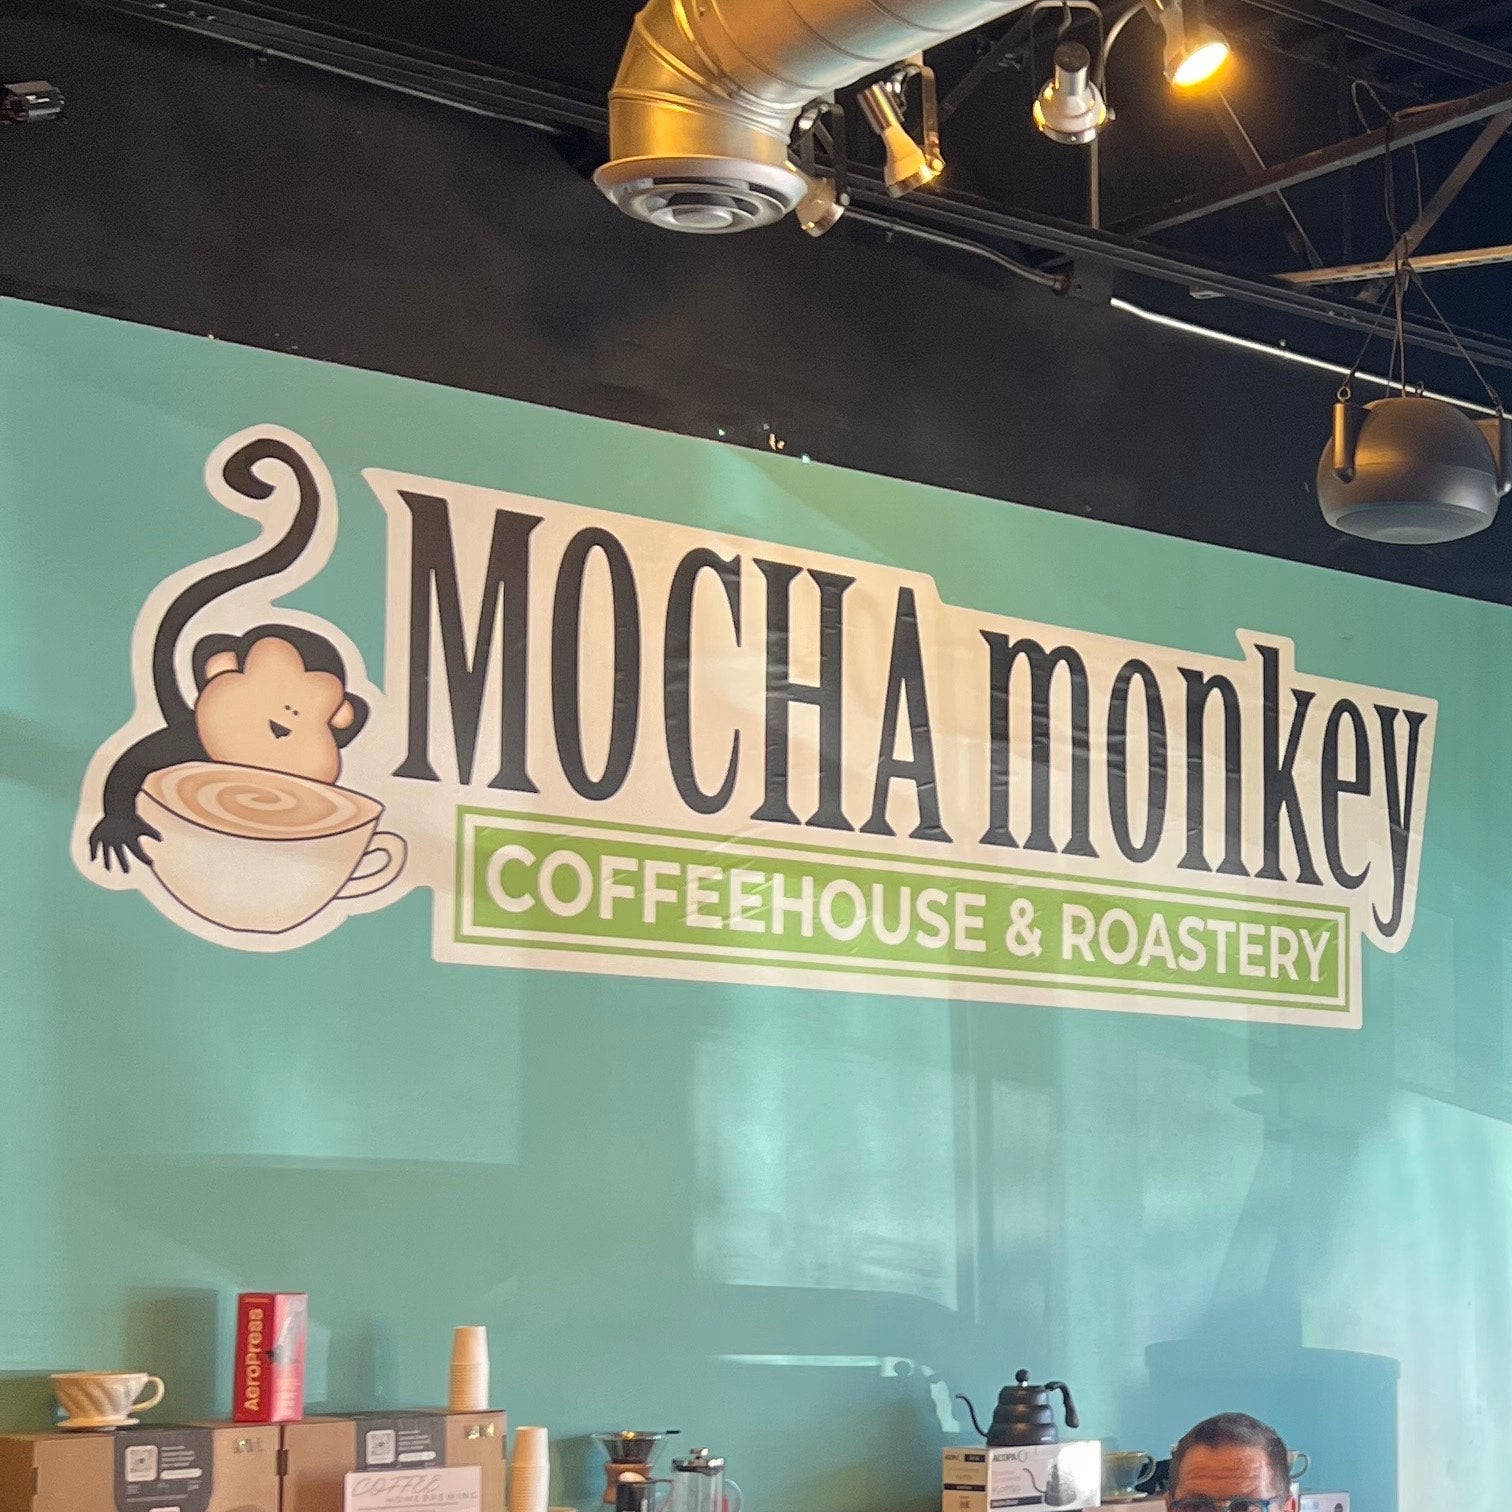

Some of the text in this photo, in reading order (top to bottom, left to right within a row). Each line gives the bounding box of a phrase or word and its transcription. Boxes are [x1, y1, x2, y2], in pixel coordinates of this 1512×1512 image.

[392, 490, 1427, 937] MOCHA monkey
[486, 845, 1331, 983] COFFEEHOUSE & ROASTERY
